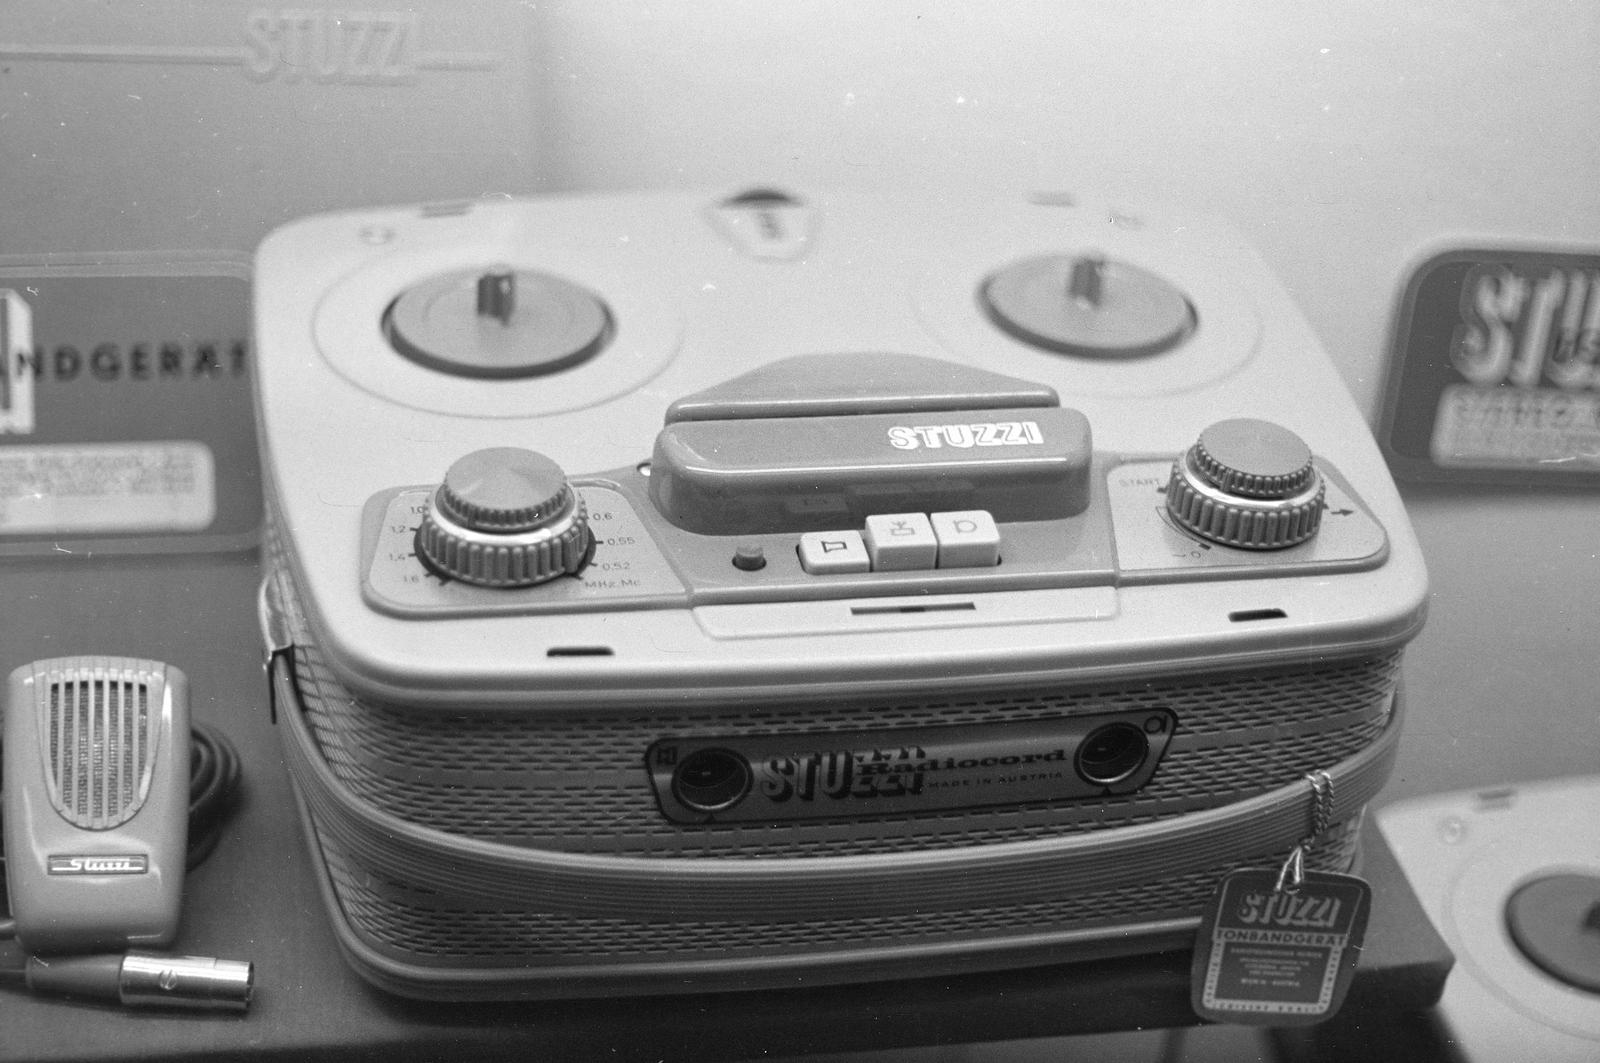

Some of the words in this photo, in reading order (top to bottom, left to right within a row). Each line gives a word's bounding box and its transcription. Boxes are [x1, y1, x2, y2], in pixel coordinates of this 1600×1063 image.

[888, 420, 1044, 450] STUZZI
[607, 536, 636, 546] 0.55
[761, 744, 926, 802] STUZZI
[1238, 893, 1341, 927] STUZZI
